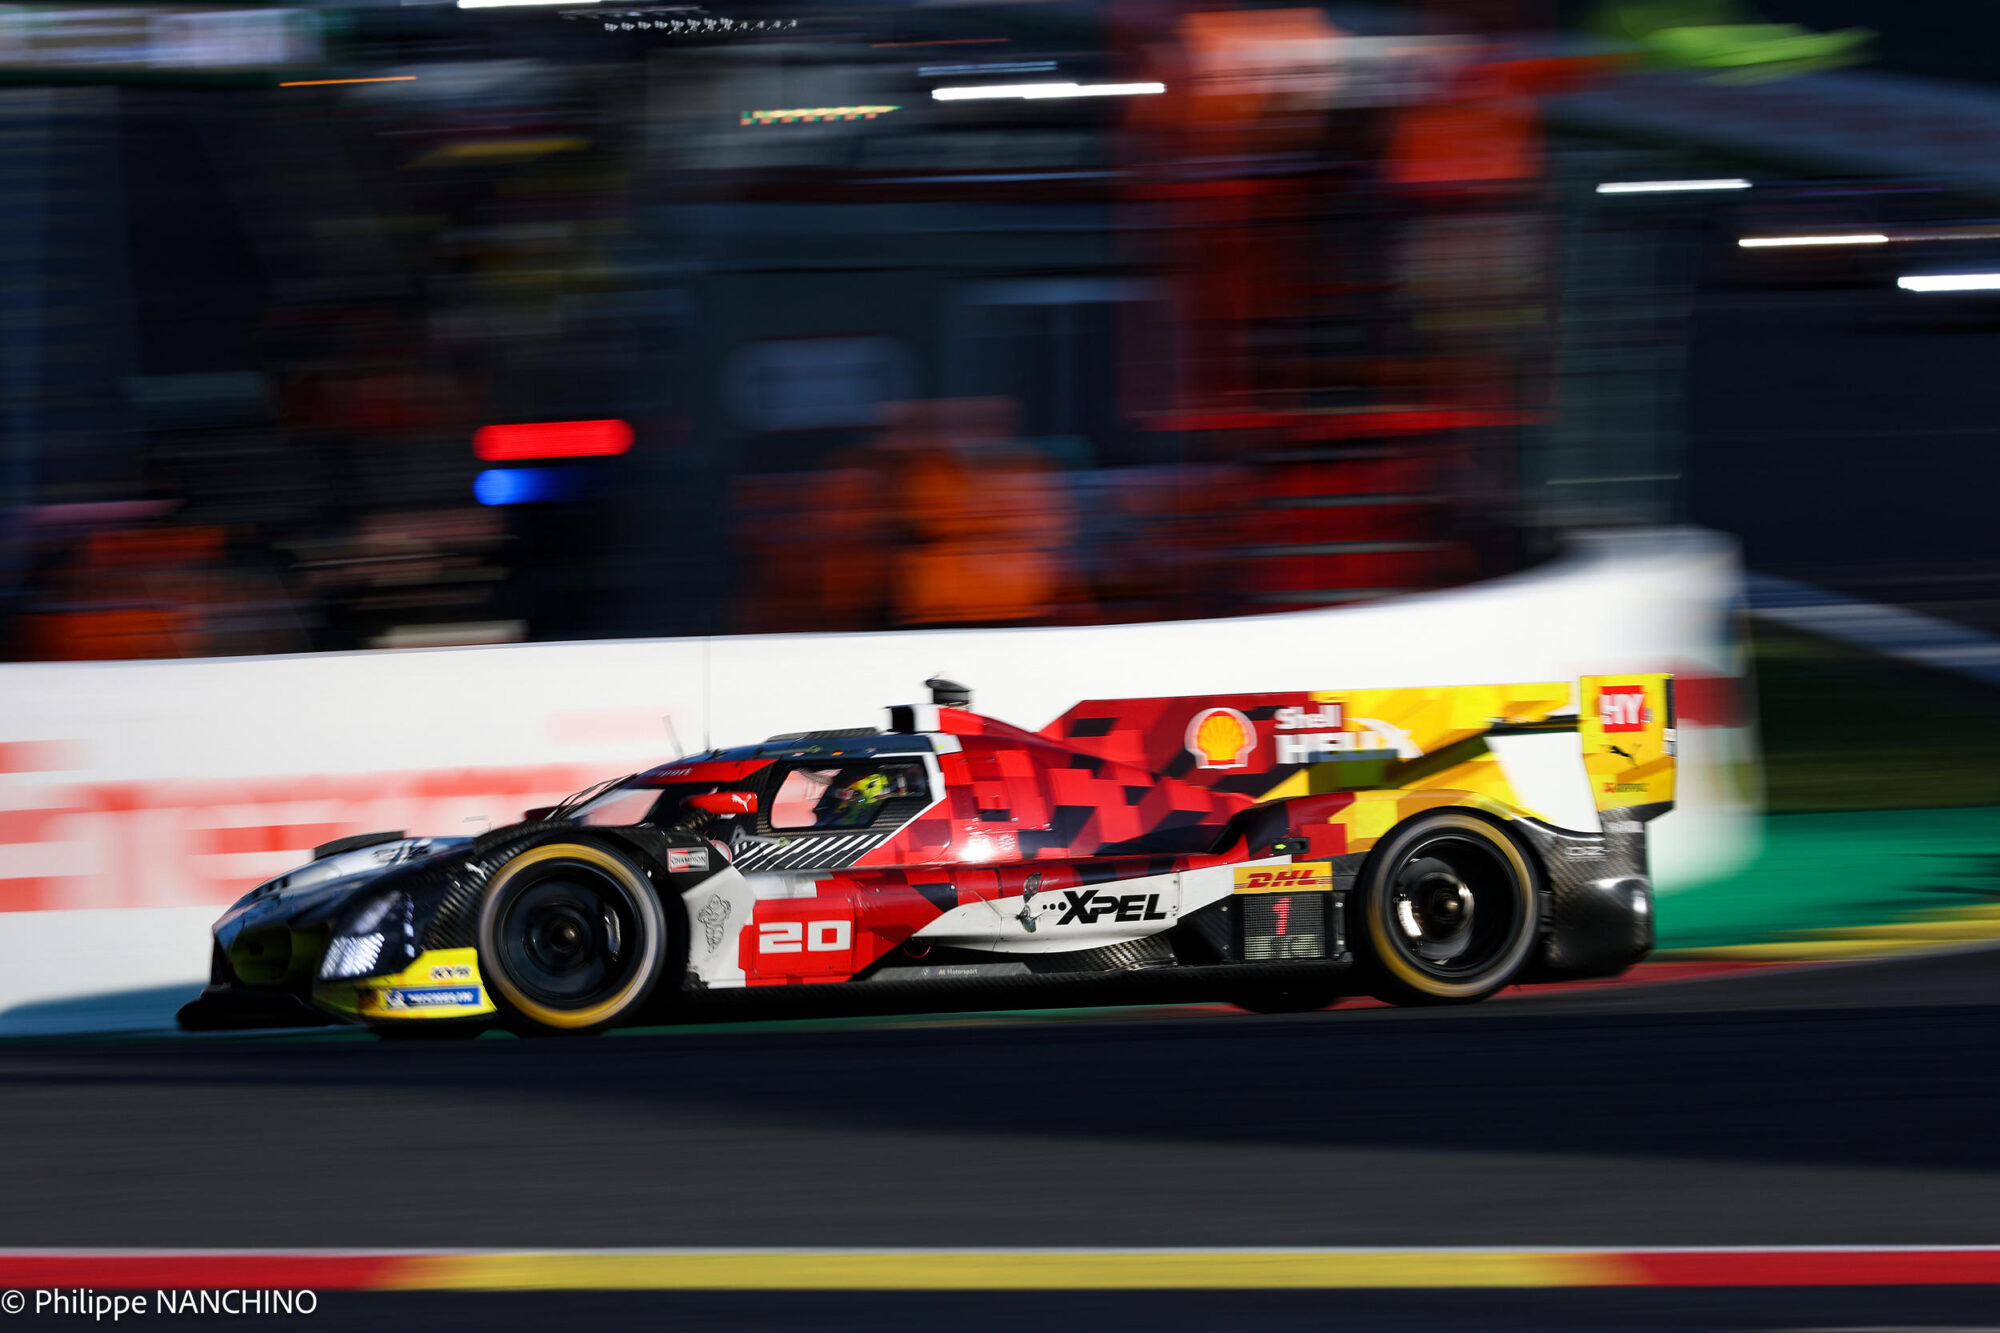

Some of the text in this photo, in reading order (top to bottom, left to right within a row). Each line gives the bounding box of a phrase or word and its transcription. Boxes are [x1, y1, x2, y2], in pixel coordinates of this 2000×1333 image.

[1275, 705, 1341, 729] Shell
[1600, 693, 1645, 724] HY
[671, 855, 707, 865] CHAMPION
[1247, 869, 1318, 888] DHL
[1056, 889, 1167, 925] XPEL
[1272, 896, 1292, 936] 1
[759, 921, 851, 954] 20
[947, 968, 978, 976] Motorsport
